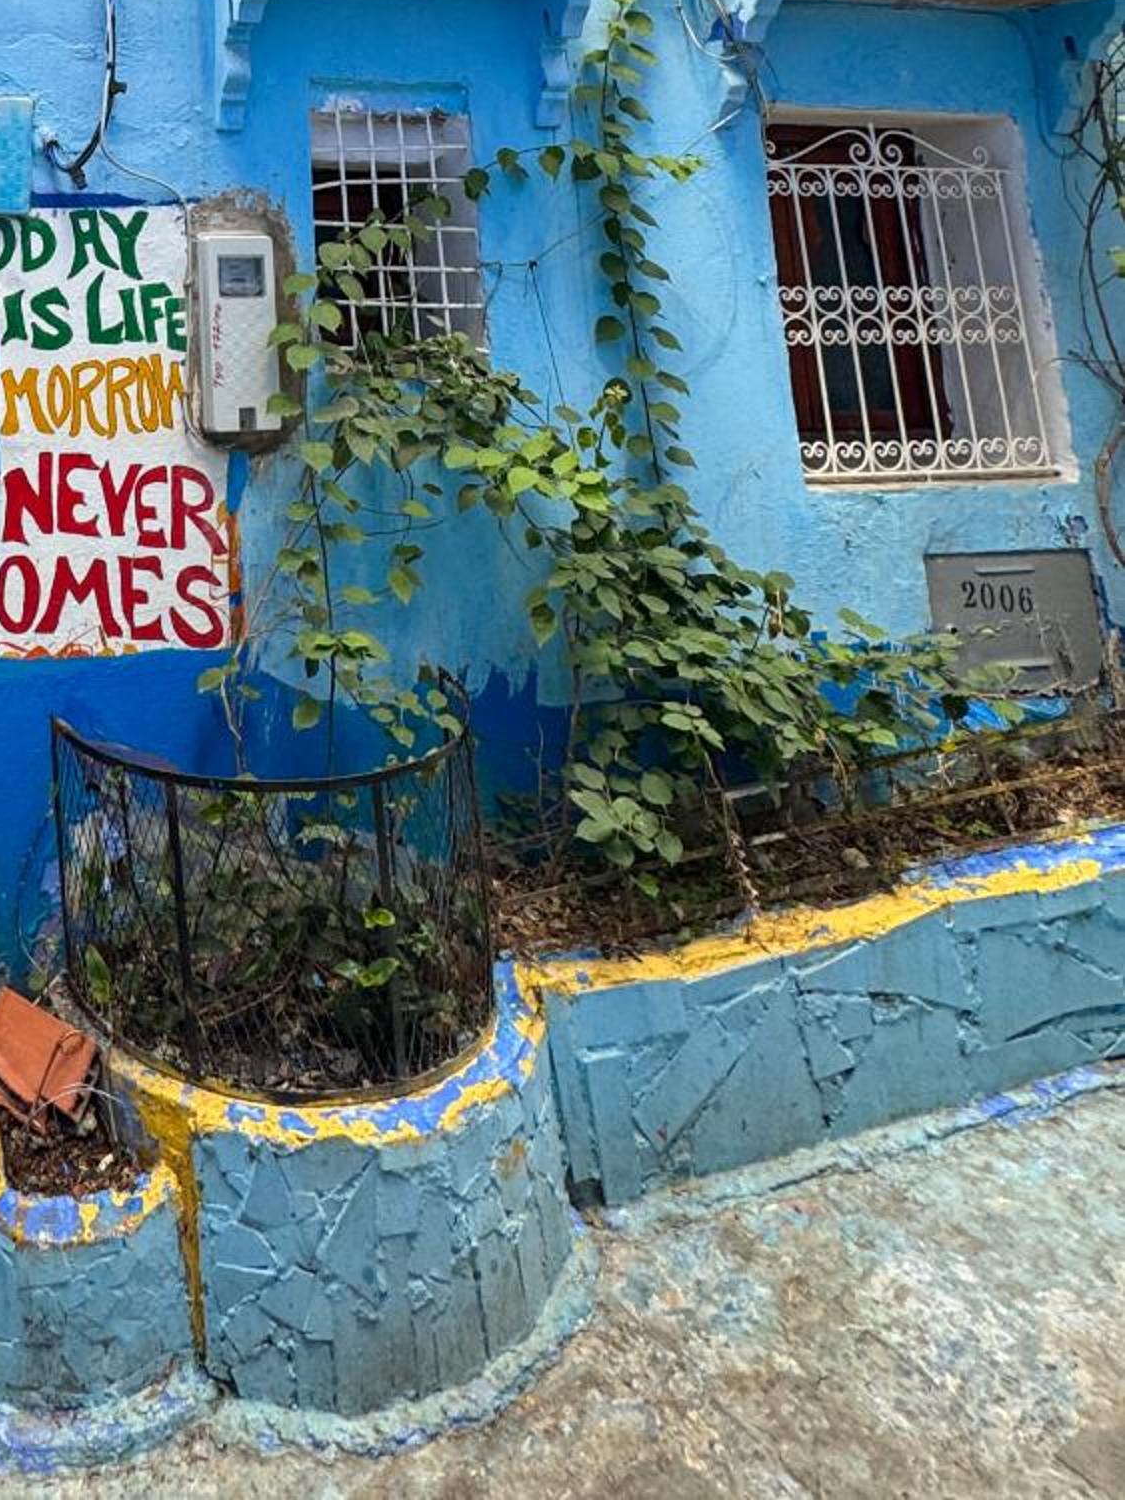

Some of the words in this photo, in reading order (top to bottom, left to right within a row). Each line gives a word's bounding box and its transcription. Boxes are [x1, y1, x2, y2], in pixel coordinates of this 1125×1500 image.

[1, 287, 73, 351] IS
[86, 273, 188, 352] LIFE
[2, 452, 230, 554] NEVER
[961, 581, 1035, 614] 2006
